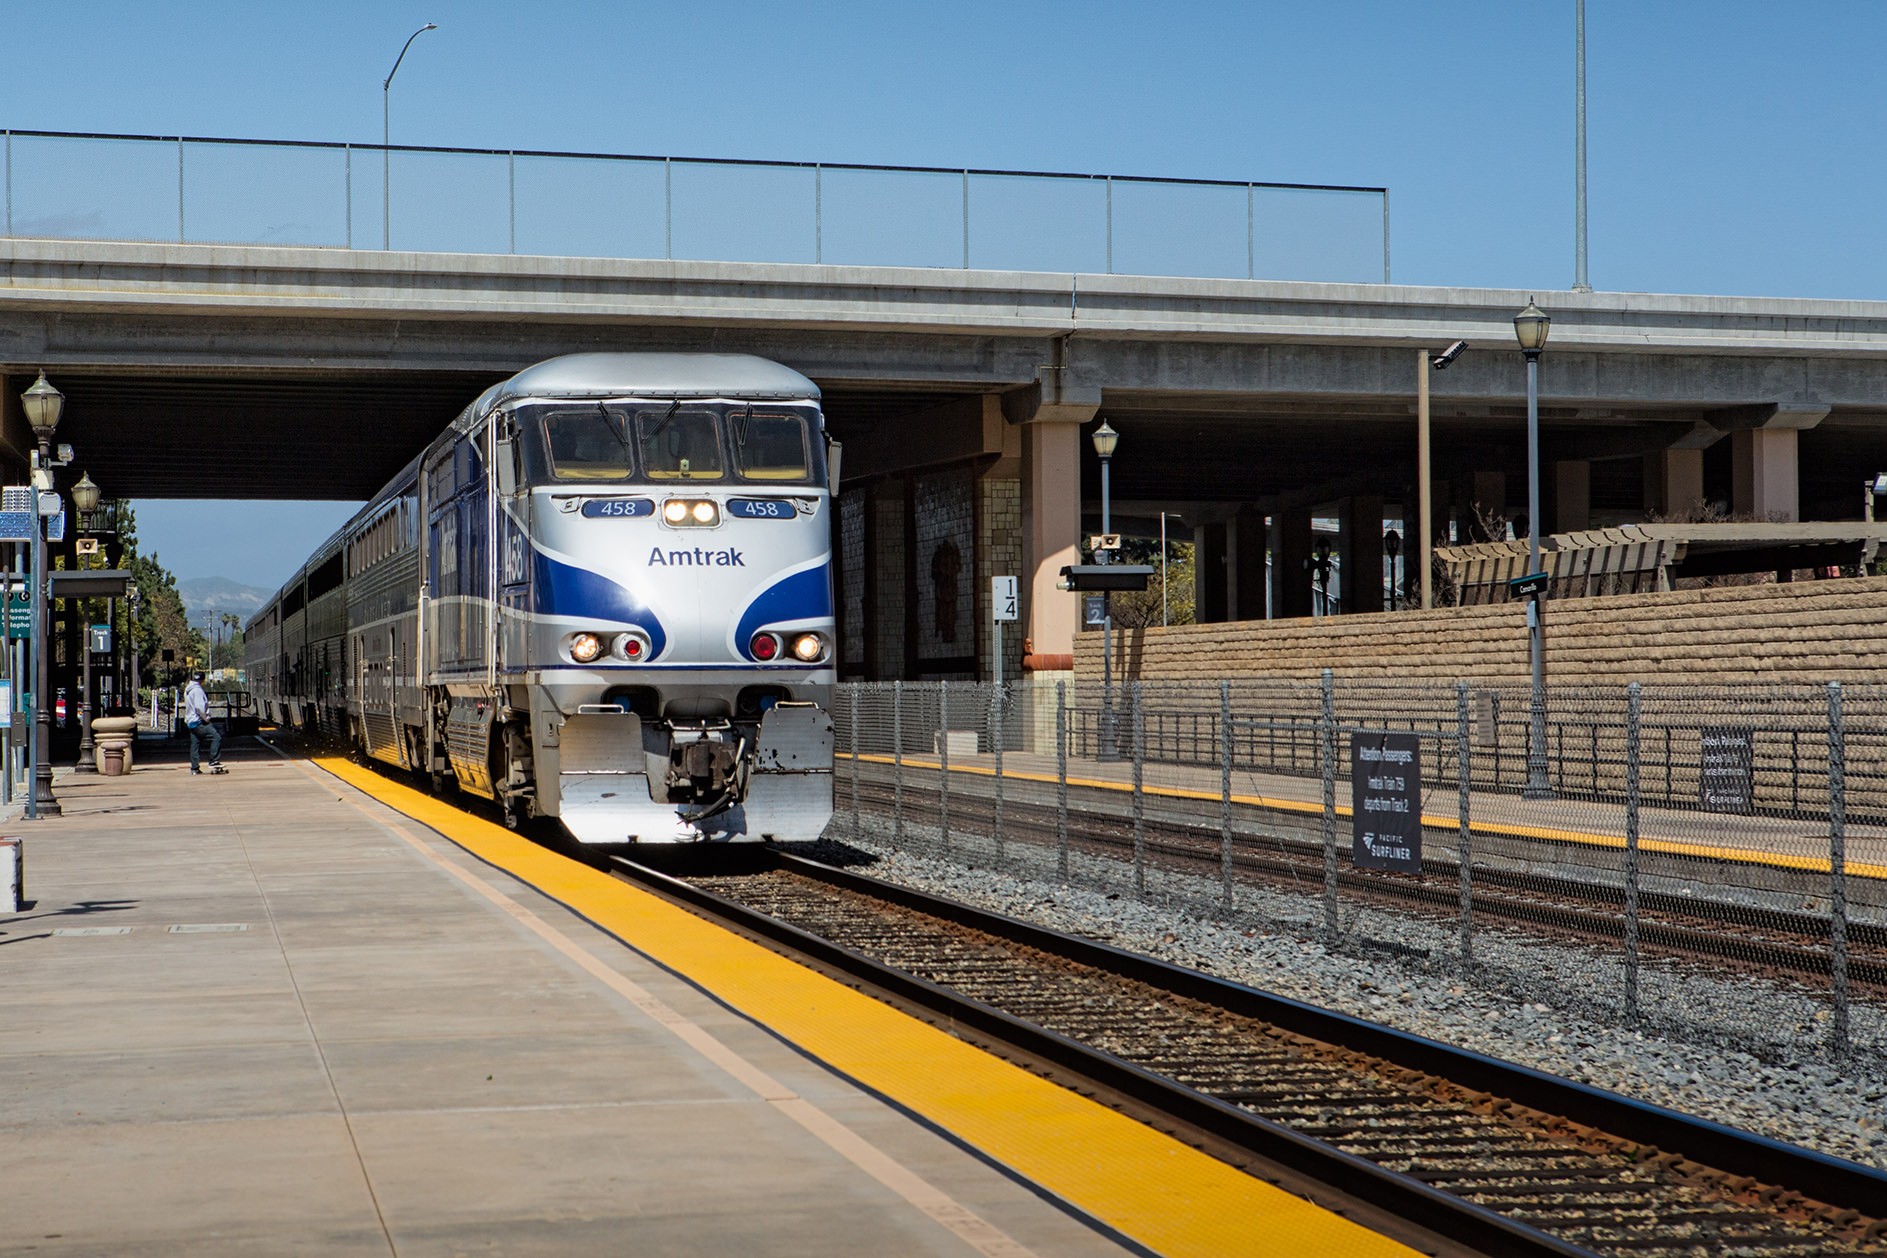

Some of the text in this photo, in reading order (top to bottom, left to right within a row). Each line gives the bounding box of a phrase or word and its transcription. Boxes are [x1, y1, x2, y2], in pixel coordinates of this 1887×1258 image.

[601, 501, 636, 516] 458
[745, 501, 779, 516] 458
[648, 547, 746, 567] Amtrak
[1090, 609, 1101, 622] 2
[98, 636, 104, 650] 1
[1379, 834, 1403, 843] PACIFIC
[1371, 844, 1411, 860] SURFLINER
